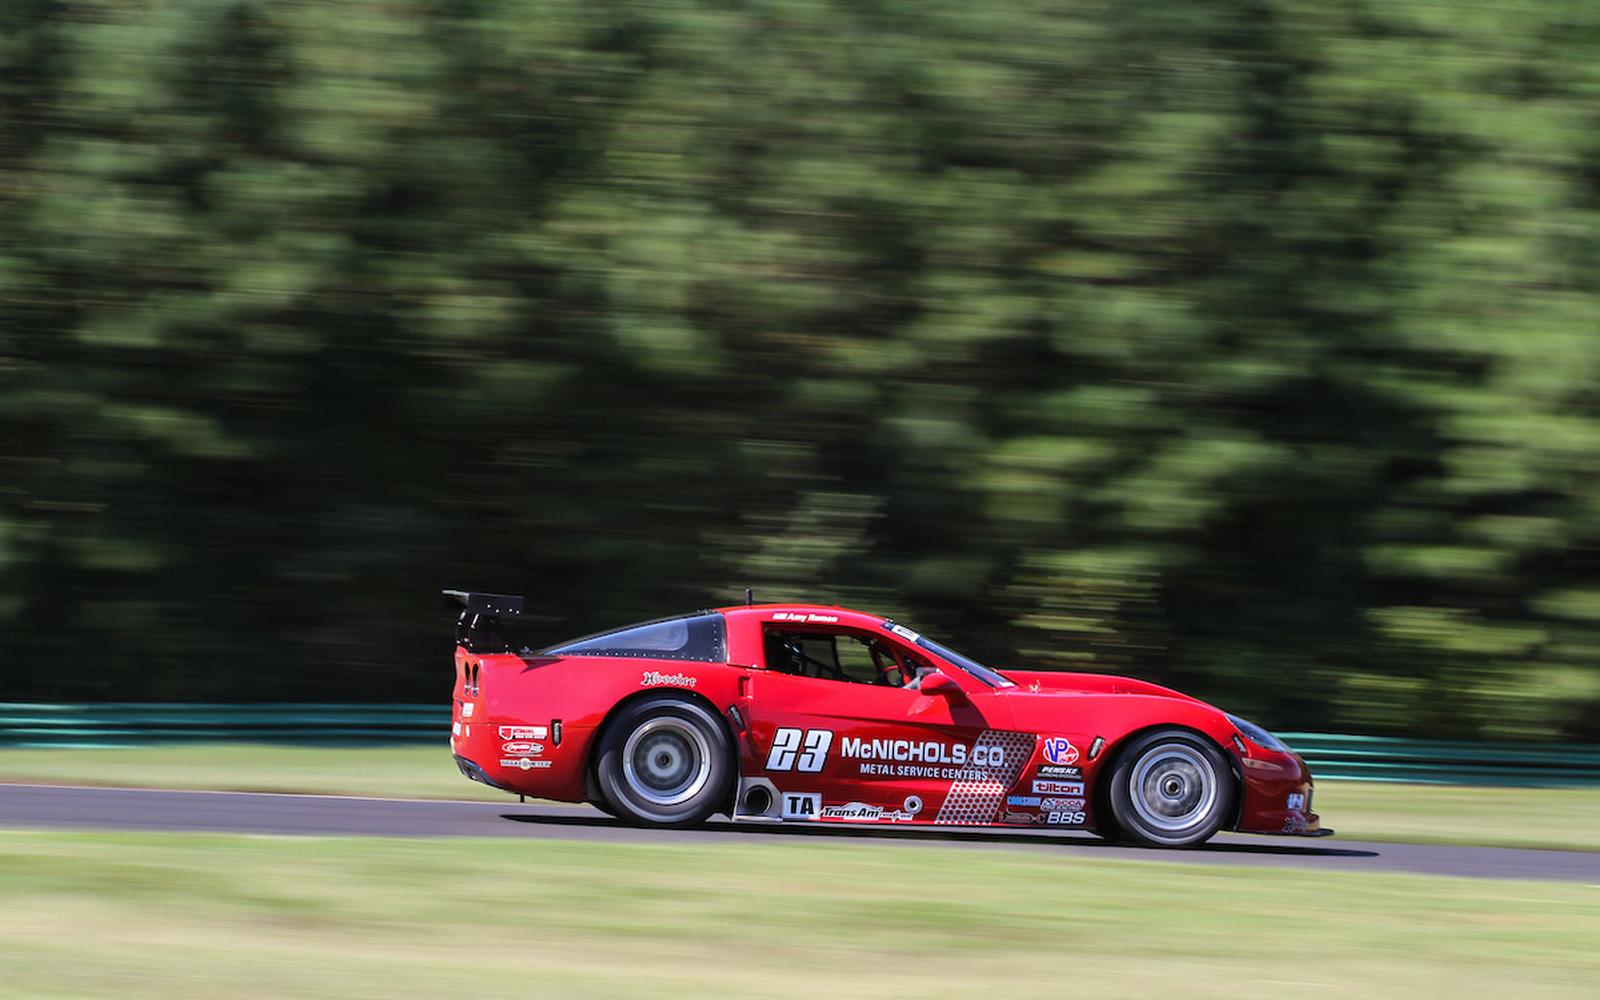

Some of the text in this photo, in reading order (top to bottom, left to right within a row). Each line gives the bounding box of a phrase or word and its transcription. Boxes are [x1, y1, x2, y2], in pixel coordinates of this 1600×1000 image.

[787, 612, 807, 622] Amy
[641, 671, 697, 687] Hoosier
[765, 727, 833, 773] 23
[841, 737, 967, 765] McNICHOLS
[1045, 737, 1070, 764] VP
[860, 763, 988, 782] METAL SERVICE CENTERS
[1041, 766, 1078, 774] PENSKE
[1036, 783, 1080, 794] tilton
[788, 796, 815, 815] TA
[1047, 812, 1086, 824] BBS
